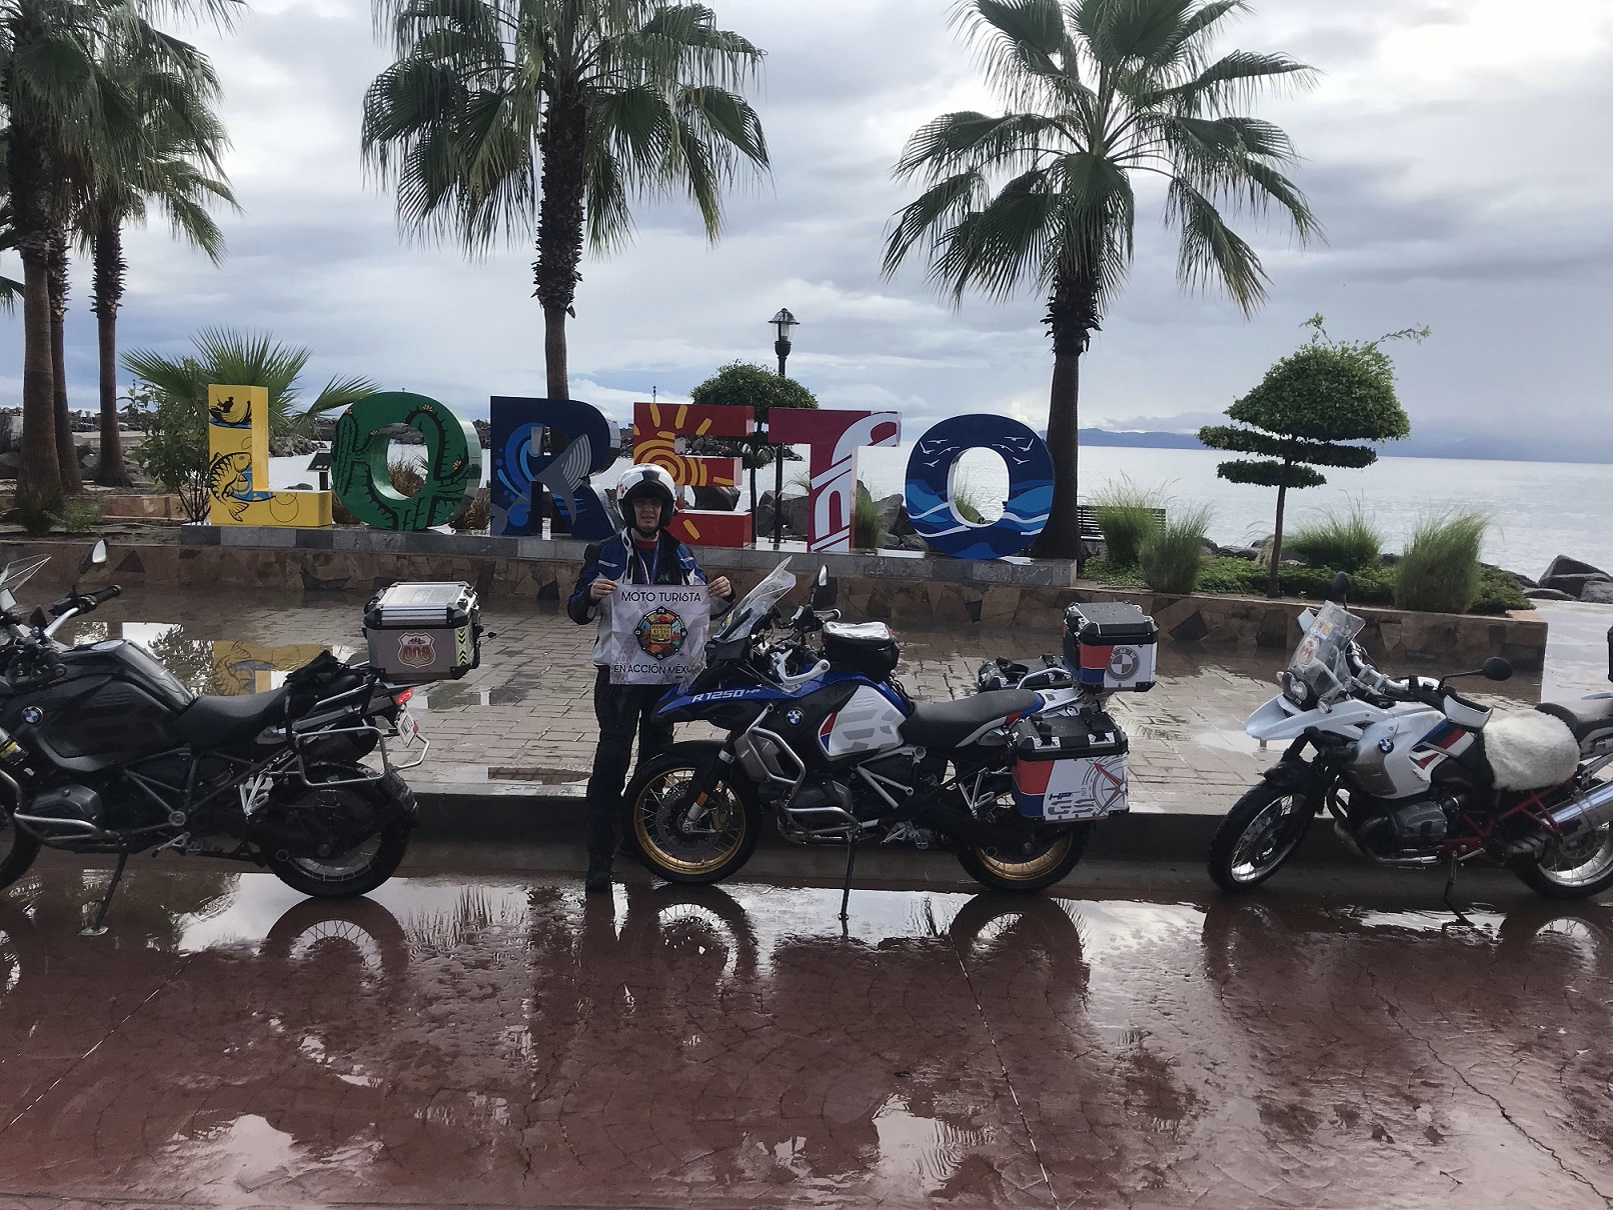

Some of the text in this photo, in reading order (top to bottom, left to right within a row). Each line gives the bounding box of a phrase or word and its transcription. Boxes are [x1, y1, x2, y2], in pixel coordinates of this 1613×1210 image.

[208, 384, 1055, 559] LORETO
[621, 591, 701, 602] MOTO TURISTA
[403, 646, 430, 660] 008
[613, 664, 626, 673] EN
[628, 663, 666, 674] ACCIÓN
[1049, 792, 1073, 800] HP
